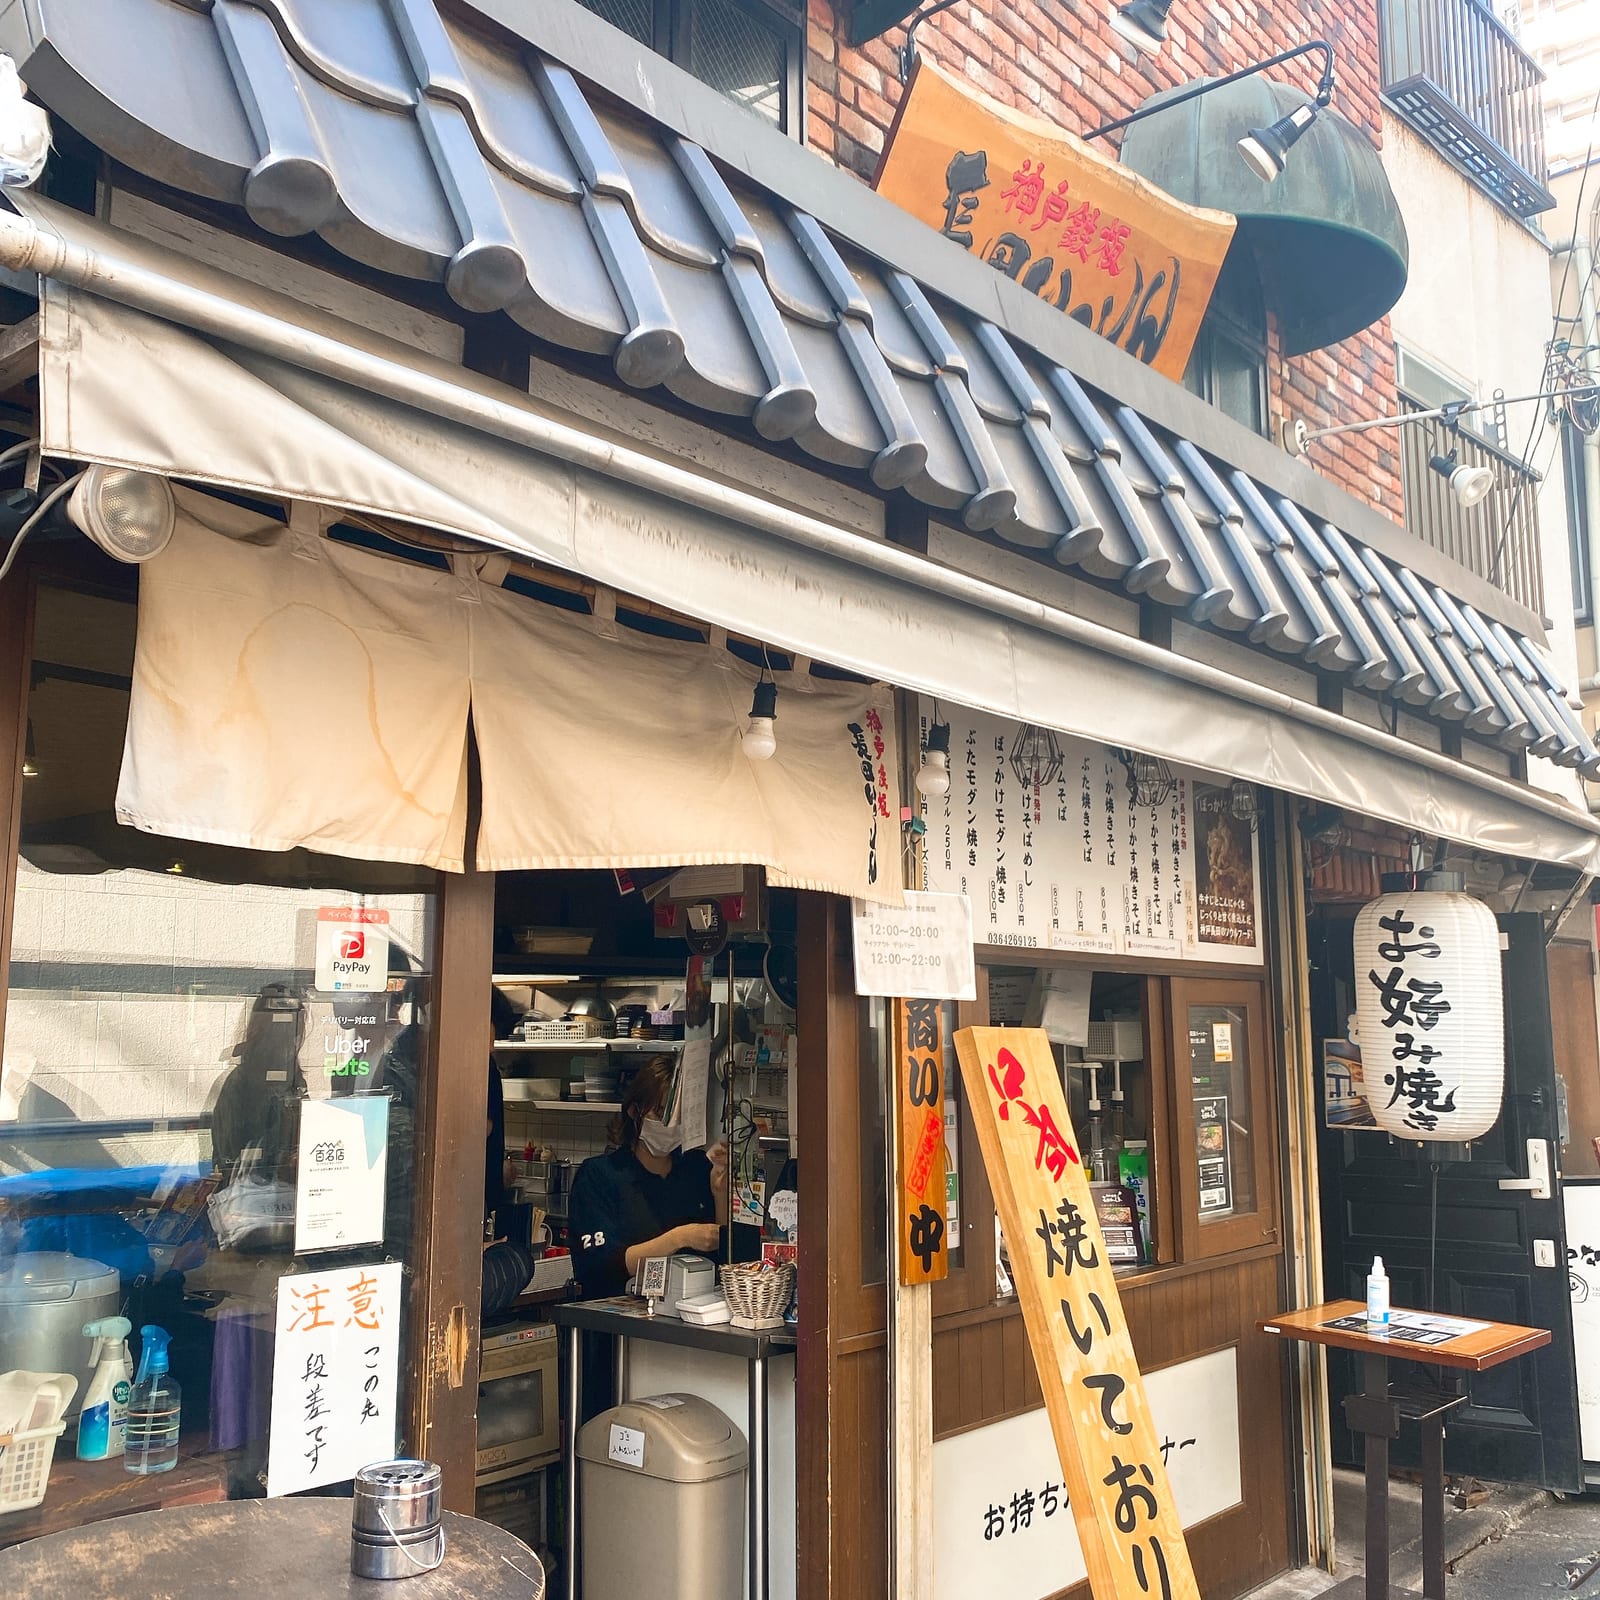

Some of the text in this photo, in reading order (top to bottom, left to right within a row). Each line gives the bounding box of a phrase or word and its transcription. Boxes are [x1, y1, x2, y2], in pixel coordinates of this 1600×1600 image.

[966, 730, 978, 866] ぶたモダン焼き
[994, 735, 1007, 904] ぼっかけモダン焼き
[1081, 757, 1092, 863] ぶた焼きそば
[1105, 763, 1116, 866] いか焼きそば
[944, 824, 952, 870] 250円
[333, 961, 371, 975] PayPay
[987, 932, 1037, 948] 0364269125
[320, 1016, 377, 1025] デリバリー対応店
[325, 1035, 370, 1054] Uber
[1369, 910, 1460, 1131] お好み焼き
[324, 1057, 370, 1077] Eats
[581, 1231, 605, 1250] 28
[909, 1204, 944, 1274] 中
[286, 1271, 384, 1332] 注意
[300, 1353, 331, 1474] 段差です
[361, 1346, 380, 1425] この先
